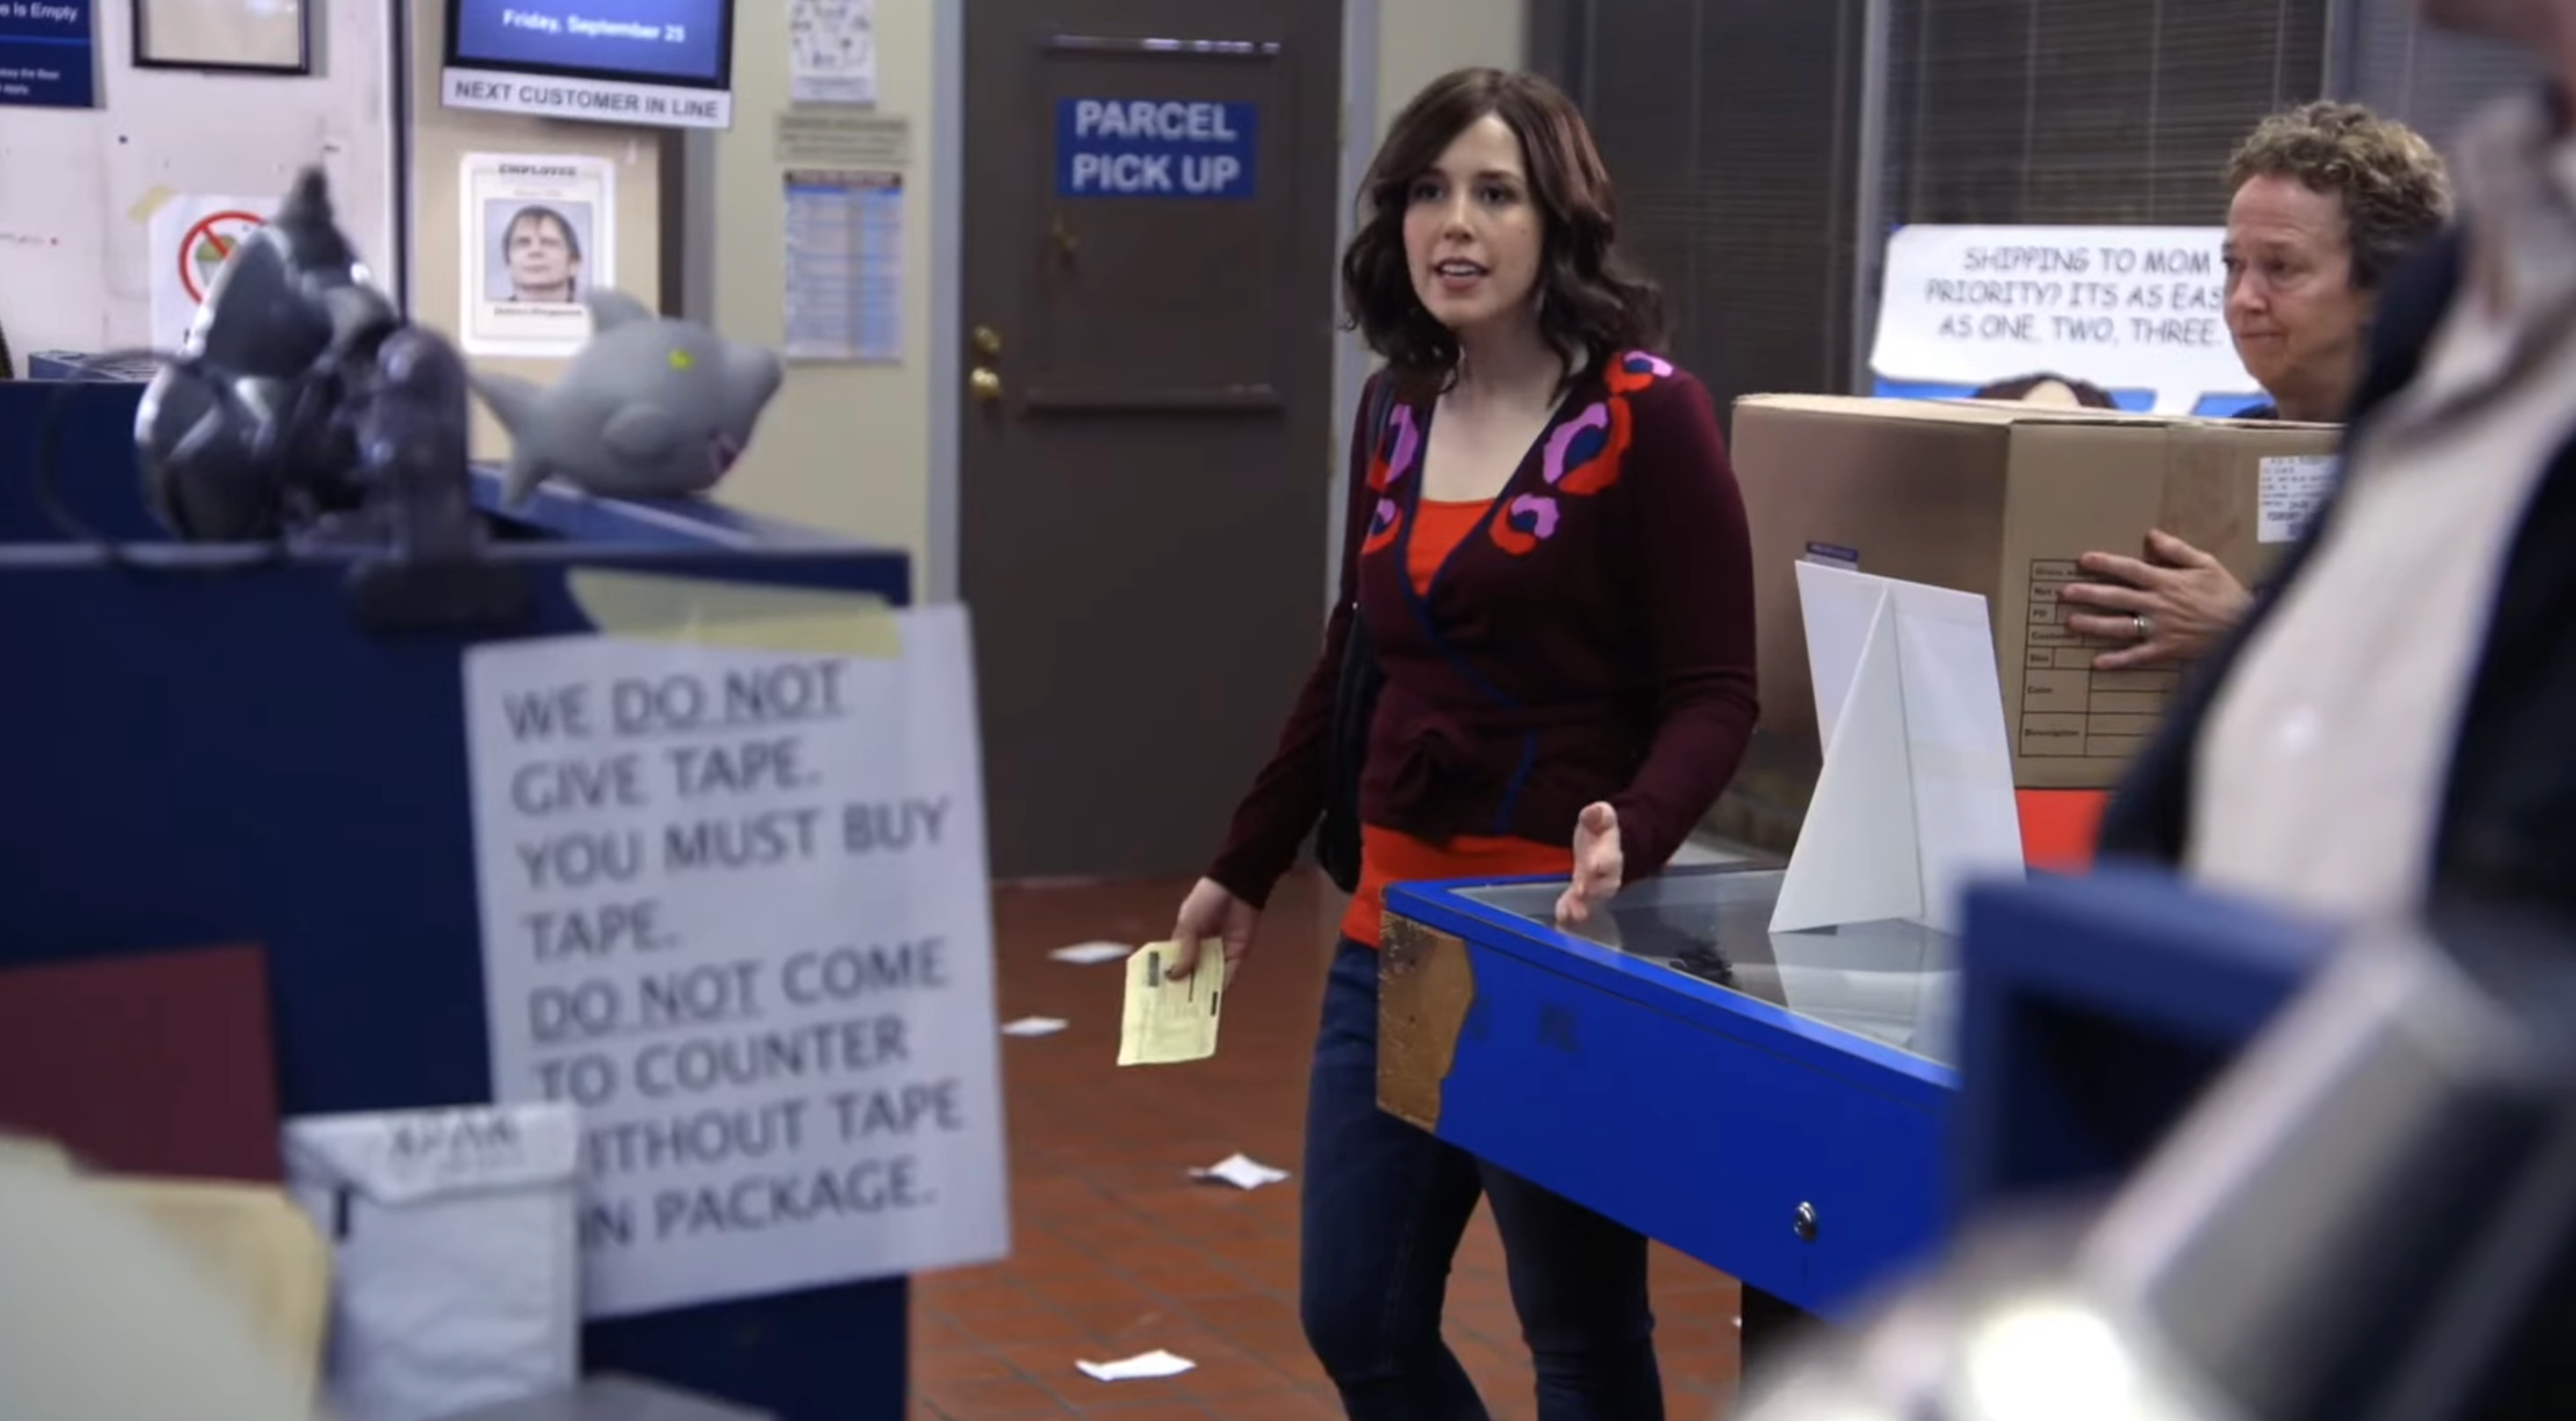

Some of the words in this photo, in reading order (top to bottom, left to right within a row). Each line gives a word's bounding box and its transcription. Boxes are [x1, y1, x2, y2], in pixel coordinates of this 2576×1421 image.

[30, 2, 79, 24] Empty
[567, 15, 661, 40] September
[454, 80, 513, 101] NEXT
[518, 84, 640, 111] CUSTOMER
[644, 95, 666, 114] IN
[672, 97, 720, 119] LINE
[1075, 99, 1239, 141] PARCEL
[1071, 152, 1175, 192] PICK
[1181, 155, 1241, 194] UP
[1962, 245, 2090, 272] SHIPPING
[2099, 247, 2137, 273] TO
[2144, 249, 2212, 276] MOM
[1924, 278, 2064, 305] PRIORITY?
[2068, 281, 2120, 307] ITS
[2126, 284, 2164, 310] AS
[2170, 282, 2224, 312] EAS
[1937, 313, 1973, 339] AS
[502, 682, 592, 741] WE
[611, 674, 705, 736] DO
[723, 660, 848, 728] NOT
[510, 753, 648, 817] GIVE
[666, 737, 822, 800] TAPE.
[514, 828, 643, 889] YOU
[662, 805, 822, 872] MUST
[840, 795, 951, 855] BUY
[520, 898, 681, 964] TAPE.
[528, 978, 621, 1045] DO
[638, 959, 765, 1028] NOT
[780, 938, 950, 1006] COME
[533, 1057, 616, 1107] TO
[632, 1013, 910, 1100] COUNTER
[585, 1097, 811, 1179] ITHOUT
[827, 1078, 967, 1145] TAPE
[579, 1198, 636, 1249] N
[651, 1155, 938, 1242] PACKAGE.
